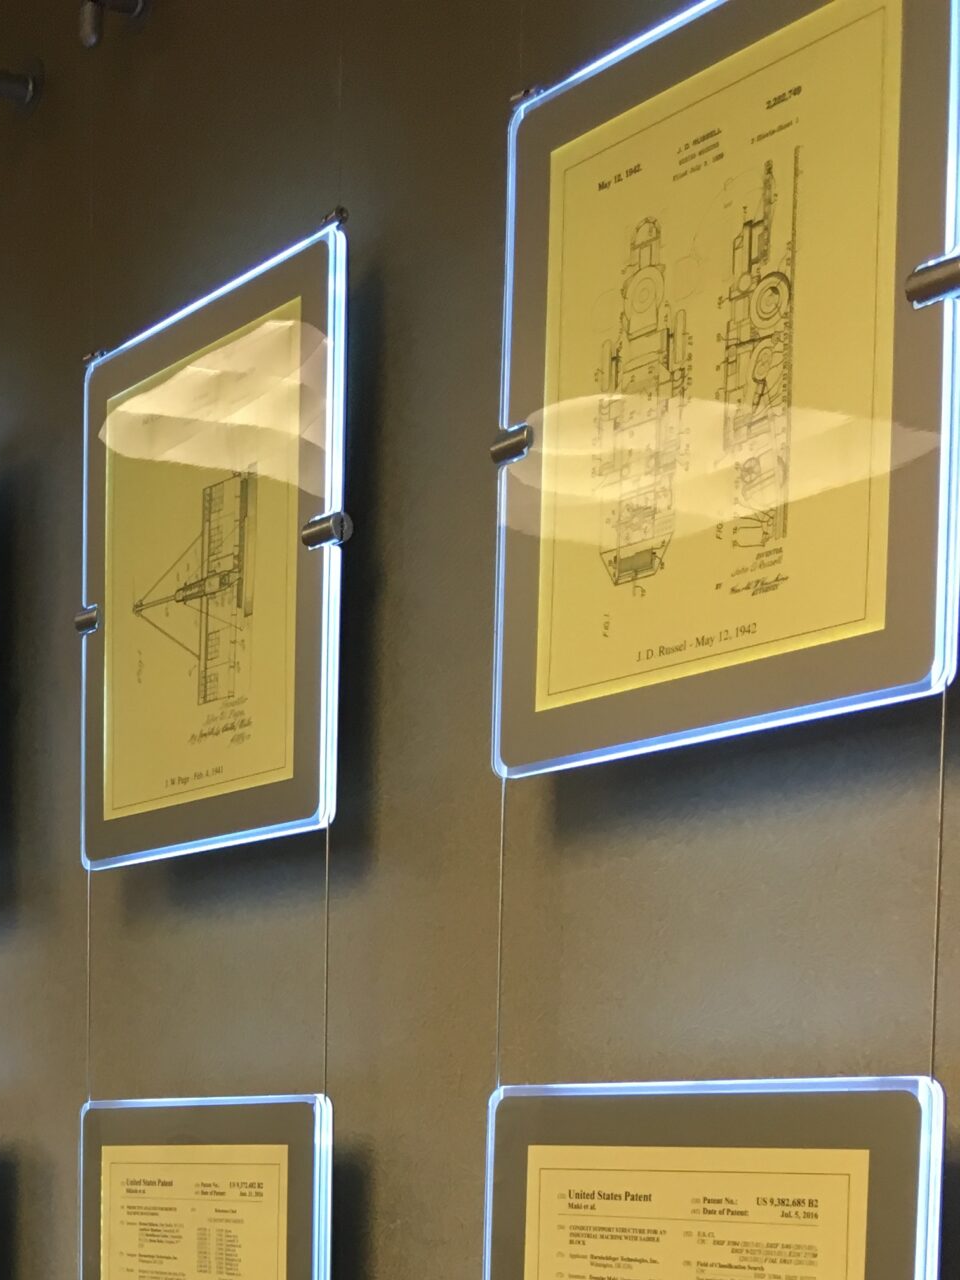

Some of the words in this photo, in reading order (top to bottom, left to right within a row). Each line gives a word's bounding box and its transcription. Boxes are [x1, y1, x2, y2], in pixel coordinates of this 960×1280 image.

[658, 639, 687, 657] Russel
[694, 635, 716, 649] May
[735, 622, 758, 638] 1942
[568, 1189, 595, 1200] United
[597, 1190, 622, 1201] States
[624, 1191, 652, 1202] Patent
[702, 1196, 723, 1204] Patent
[756, 1196, 768, 1206] US
[808, 1198, 819, 1208] B2
[702, 1207, 716, 1215] Date
[718, 1207, 725, 1215] of
